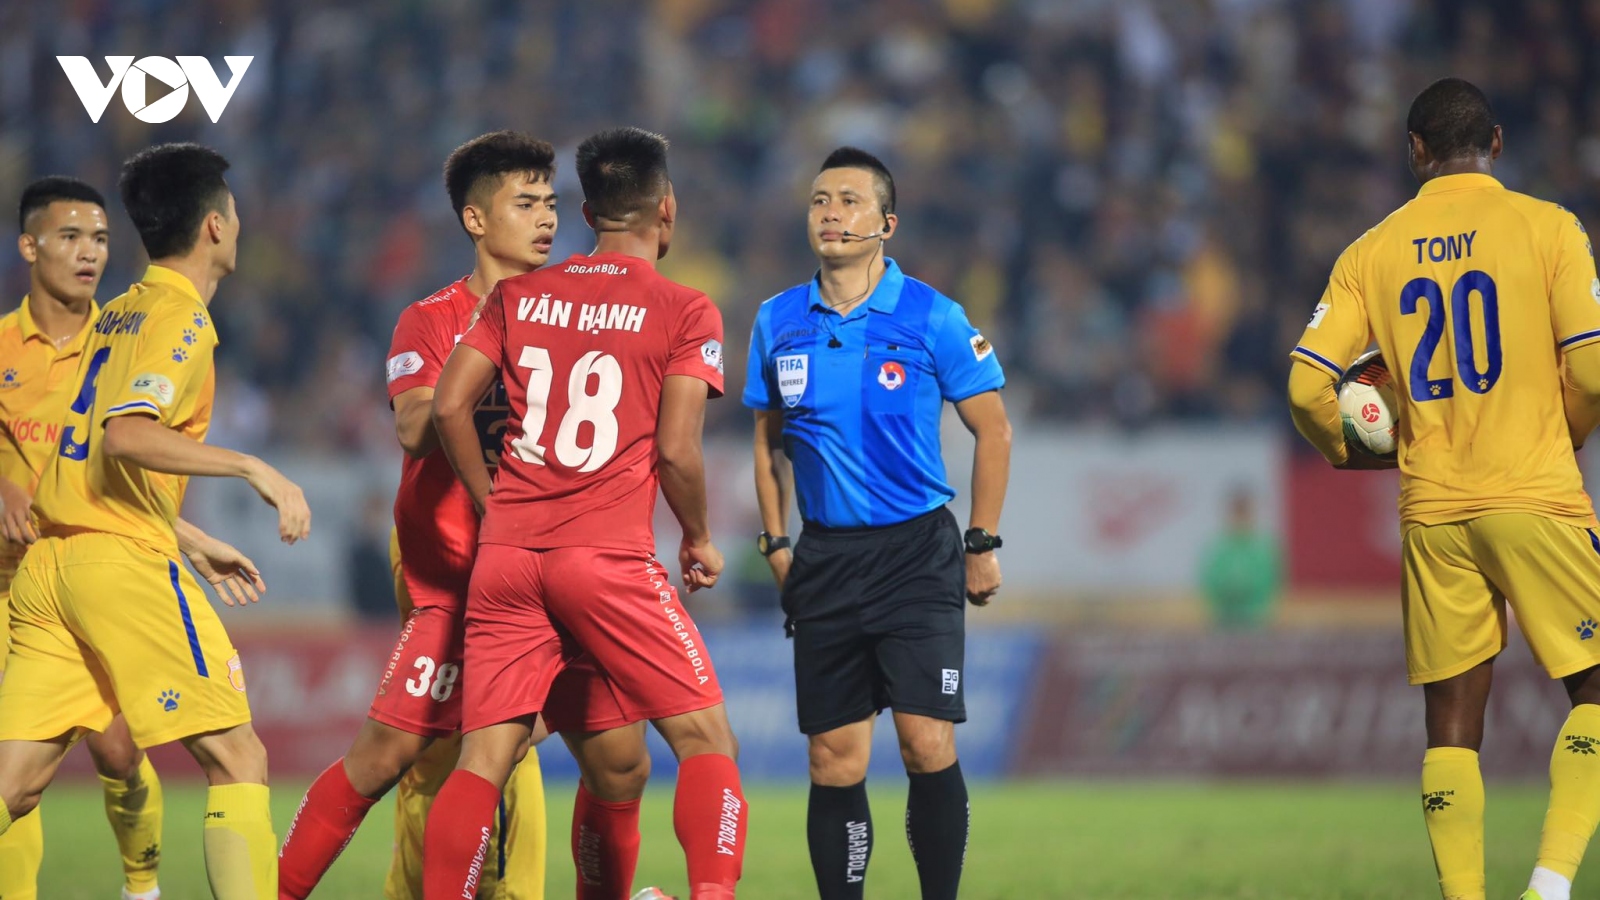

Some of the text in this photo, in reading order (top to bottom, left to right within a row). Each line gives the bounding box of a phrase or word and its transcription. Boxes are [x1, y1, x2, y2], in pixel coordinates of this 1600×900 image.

[564, 264, 628, 275] JOGARBOLA
[1413, 230, 1477, 264] TONY
[517, 293, 646, 335] VĂN HẠNH
[1400, 270, 1502, 401] 20
[780, 358, 804, 372] FIFA
[781, 378, 804, 387] REFEREE
[510, 345, 623, 473] 18
[378, 618, 416, 696] JOGARBOLA
[664, 606, 709, 685] JOGARBOLA
[405, 656, 459, 702] 38
[204, 811, 225, 819] ME
[716, 787, 741, 856] JOGARBOLA
[845, 820, 867, 883] JOGARBOLA
